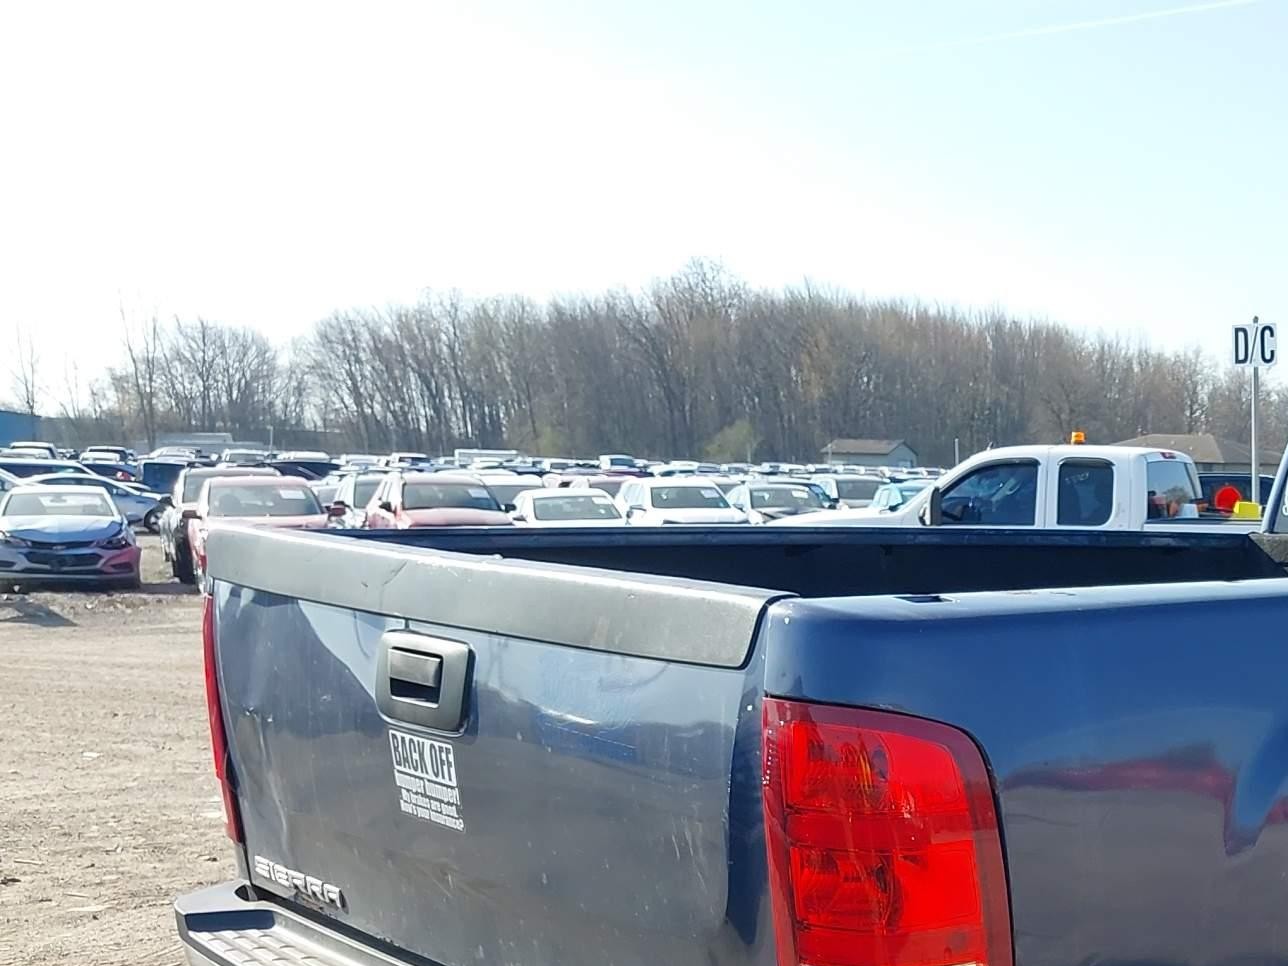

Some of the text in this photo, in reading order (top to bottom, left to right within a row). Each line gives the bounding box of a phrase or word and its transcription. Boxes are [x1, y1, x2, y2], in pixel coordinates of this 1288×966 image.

[1234, 325, 1275, 365] D/C
[391, 733, 453, 782] BACK OFF
[254, 855, 343, 908] SIERRA
